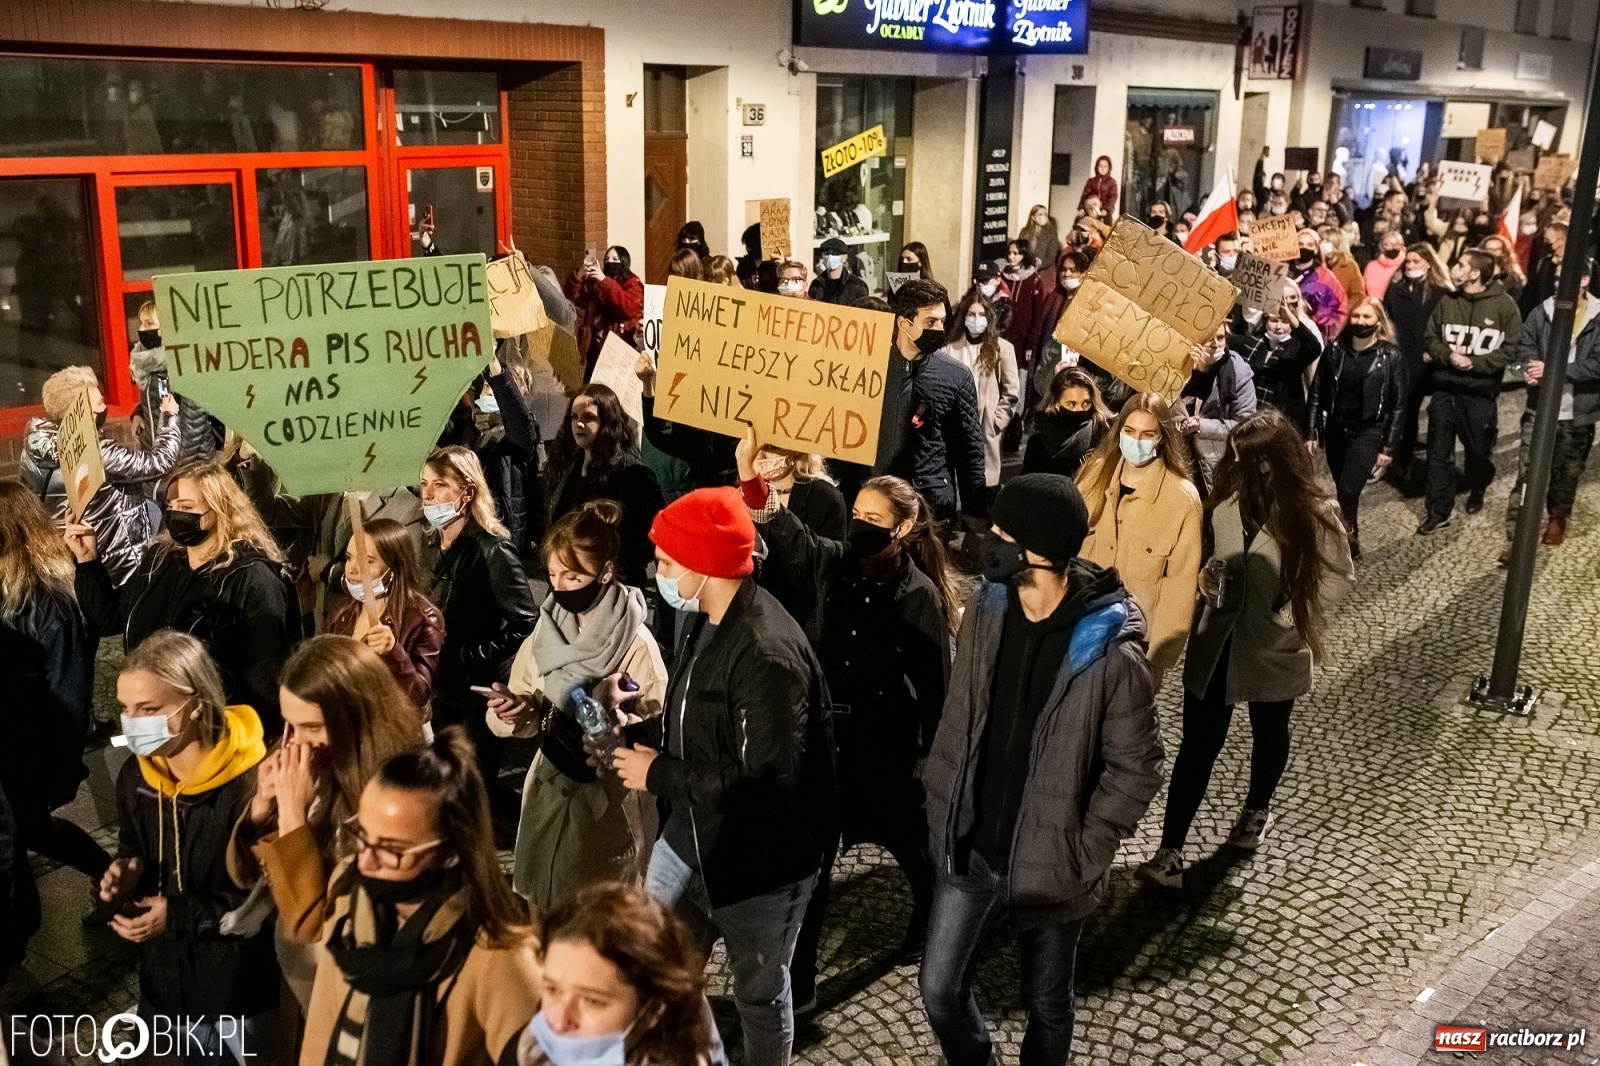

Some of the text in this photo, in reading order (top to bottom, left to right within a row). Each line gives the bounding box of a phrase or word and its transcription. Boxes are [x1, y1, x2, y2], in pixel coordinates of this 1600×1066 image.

[749, 107, 764, 121] 36
[824, 143, 857, 173] ZŁOTO
[1251, 217, 1291, 234] CHCEMY
[1262, 242, 1278, 253] NIE
[1128, 230, 1222, 298] MOJE
[169, 263, 485, 334] NIE POTRZEBUJE
[1111, 258, 1215, 331] CIAŁO
[676, 290, 877, 357] NAWET MEFEDRON
[165, 321, 482, 376] TINDERA PIS RUCHA
[674, 333, 701, 362] MA
[717, 340, 798, 381] LEPSZY
[808, 359, 883, 399] SKŁAD
[285, 373, 340, 406] NAS
[264, 407, 422, 446] CODZIENNIE
[700, 384, 868, 454] NIŻ RZĄD
[65, 431, 87, 474] TO HELL
